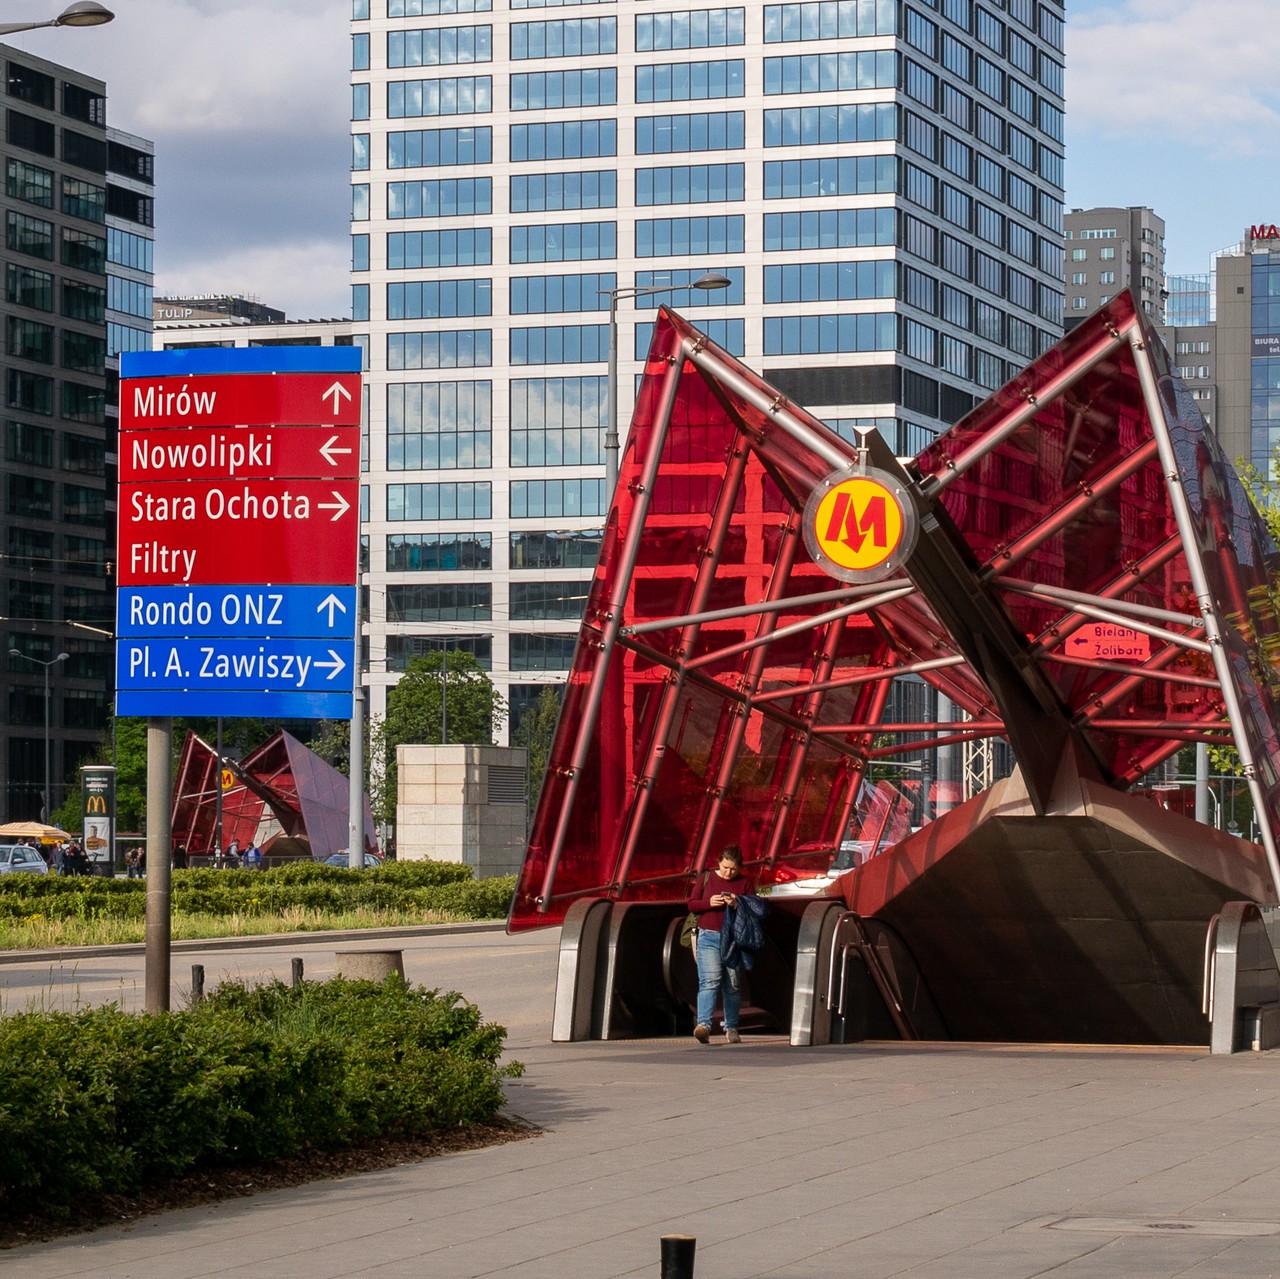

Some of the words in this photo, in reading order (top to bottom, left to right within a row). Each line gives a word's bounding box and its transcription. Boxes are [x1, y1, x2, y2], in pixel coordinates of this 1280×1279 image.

[157, 308, 192, 318] TULIP
[1254, 337, 1279, 345] BIURA
[133, 383, 217, 418] Mirów
[132, 434, 272, 475] Nowolipki
[131, 491, 196, 522] Stara
[205, 487, 311, 520] Ochota
[131, 541, 197, 581] Filtry
[130, 592, 212, 626] Rondo
[221, 594, 283, 625] ONZ
[130, 647, 157, 678] Pl.
[164, 647, 190, 678] A.
[199, 647, 312, 687] Zawiszy
